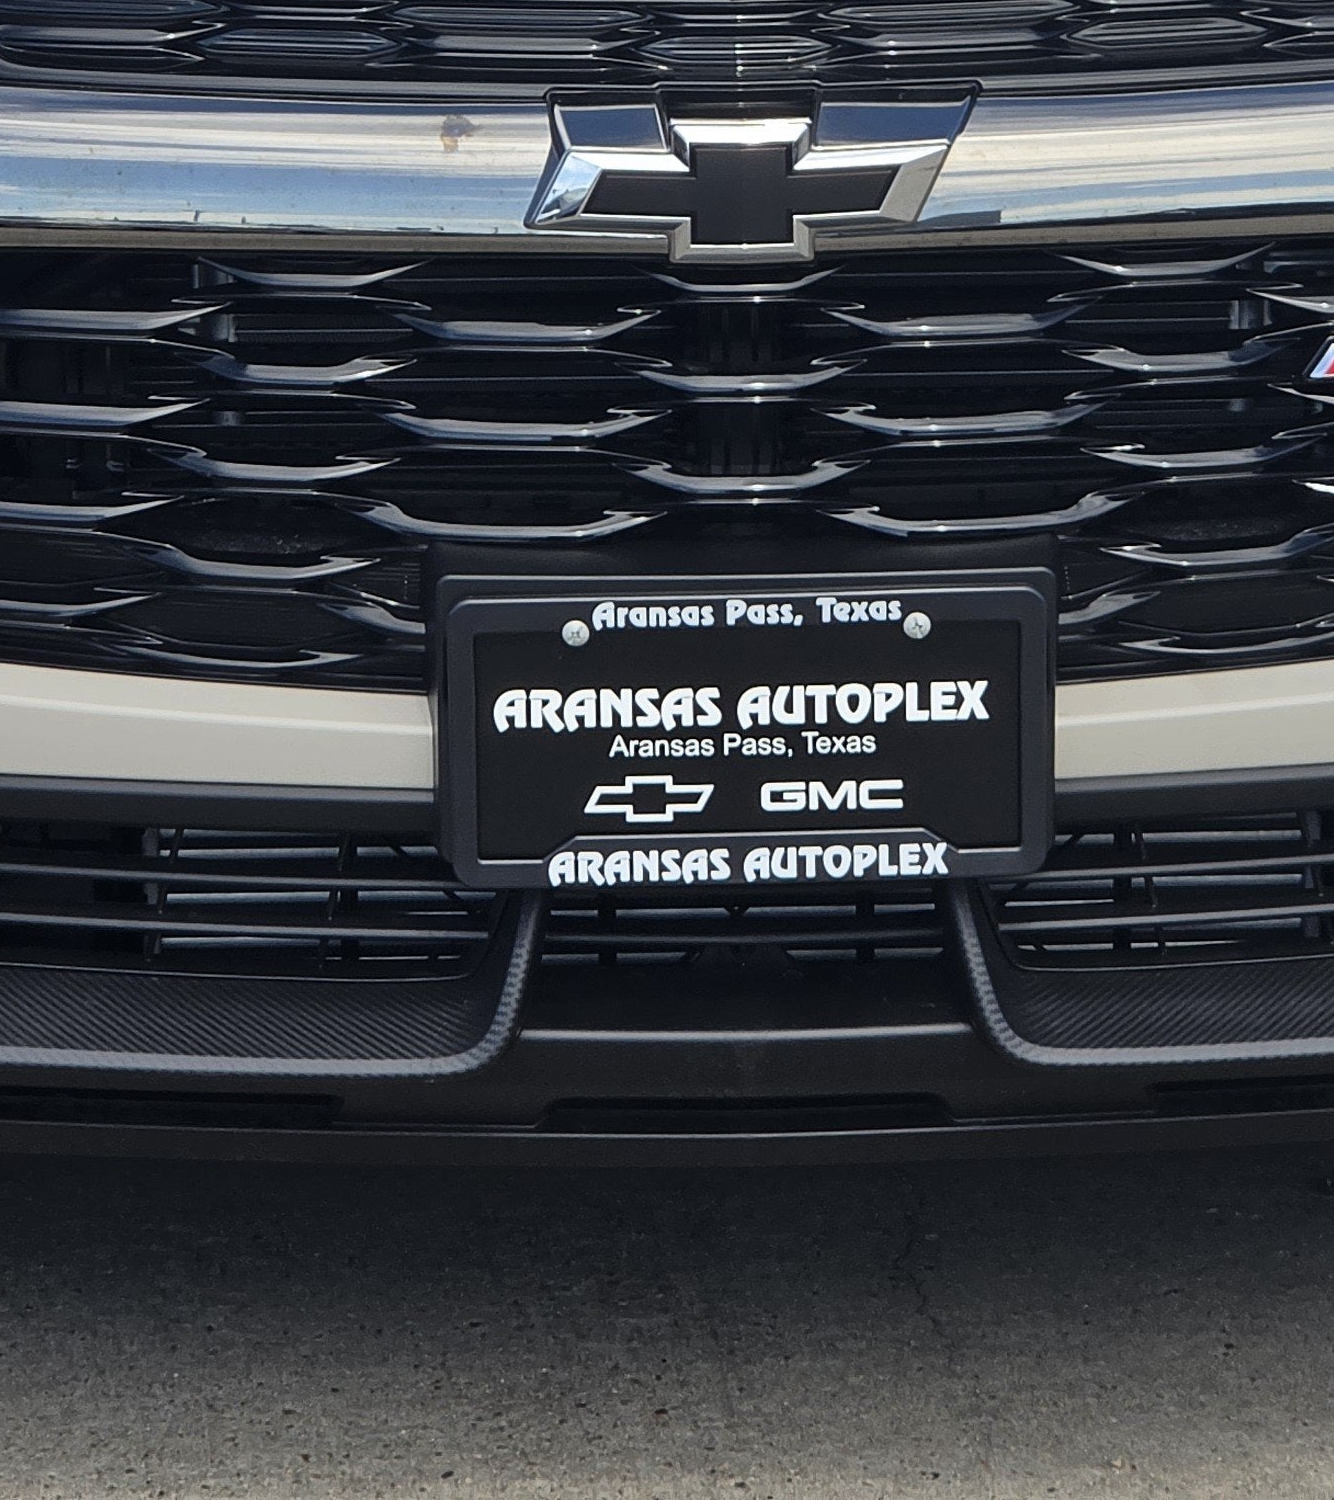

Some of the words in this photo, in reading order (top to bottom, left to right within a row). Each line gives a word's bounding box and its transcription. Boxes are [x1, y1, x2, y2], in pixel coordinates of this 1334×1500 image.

[592, 600, 715, 632] Aransas
[726, 598, 804, 627] Pass,
[816, 597, 903, 623] Texas
[493, 687, 723, 735] ARANSAS
[736, 680, 990, 729] AUTOPLEX
[609, 735, 715, 759] Aransas
[724, 733, 793, 759] Pass,
[802, 731, 877, 755] Texas
[760, 779, 905, 812] GMC
[548, 848, 731, 888] ARANSAS
[743, 842, 949, 883] AUTOPLEX
